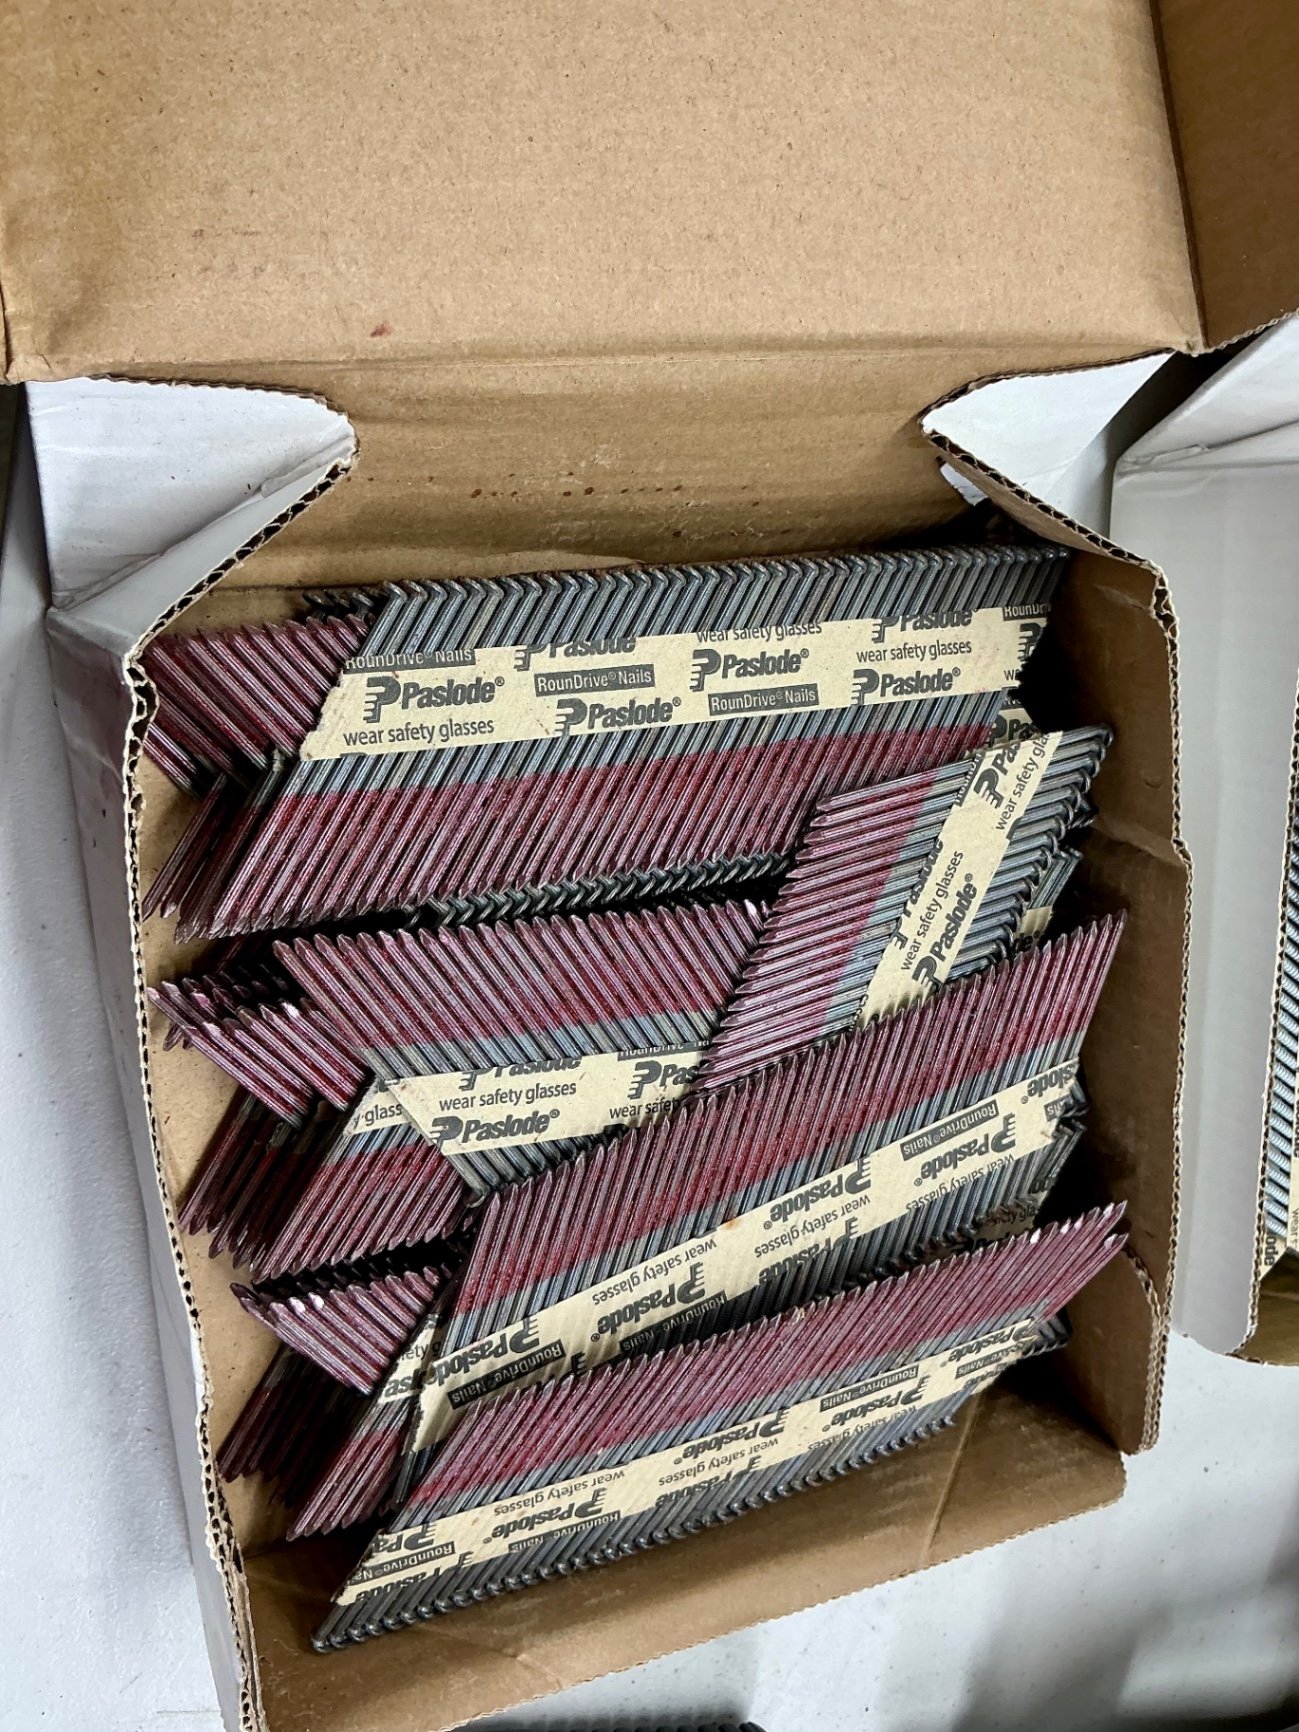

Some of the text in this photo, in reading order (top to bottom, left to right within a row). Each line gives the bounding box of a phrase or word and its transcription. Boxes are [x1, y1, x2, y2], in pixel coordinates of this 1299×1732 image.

[857, 639, 972, 663] wear safety glasses
[618, 669, 652, 685] Nails
[784, 688, 816, 704] Nails
[343, 718, 494, 746] wear safety glasses
[995, 797, 1018, 831] wear
[1012, 757, 1039, 798] safety
[900, 850, 964, 971] wear safety glasses
[439, 1082, 577, 1111] wear safety glasses
[364, 1103, 403, 1127] glass
[609, 1104, 643, 1119] wear
[903, 1134, 933, 1156] Nails
[754, 1194, 871, 1258] wear safety glasses
[592, 1238, 718, 1306] wear safety glasses
[451, 1380, 487, 1403] Nails
[822, 1391, 852, 1408] Nails
[658, 1437, 779, 1487] wear safety glasses
[494, 1470, 625, 1516] wear safety glasses
